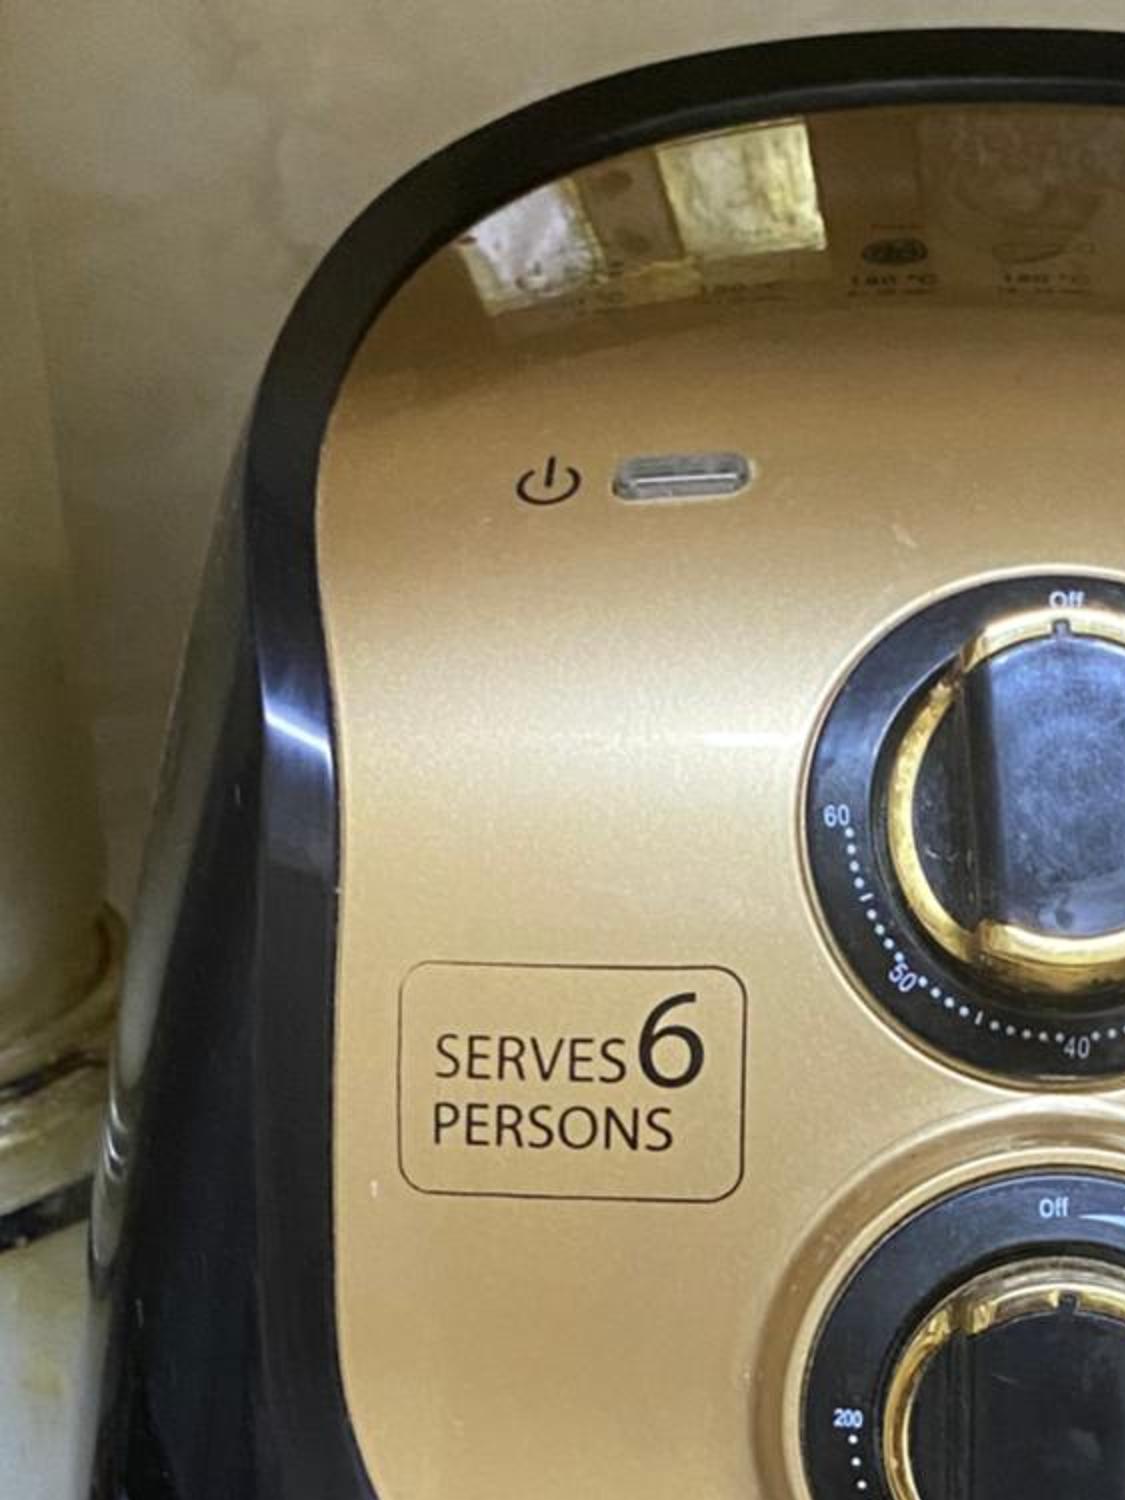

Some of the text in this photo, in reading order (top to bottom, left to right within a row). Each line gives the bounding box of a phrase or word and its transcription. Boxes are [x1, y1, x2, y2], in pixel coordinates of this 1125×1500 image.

[1048, 589, 1085, 610] Off
[823, 804, 850, 828] 60
[888, 963, 918, 993] 50
[435, 991, 705, 1089] SERVES 6
[1063, 1036, 1091, 1059] 40
[433, 1101, 673, 1152] PERSONS
[1039, 1197, 1070, 1219] Off
[833, 1408, 864, 1429] 200
